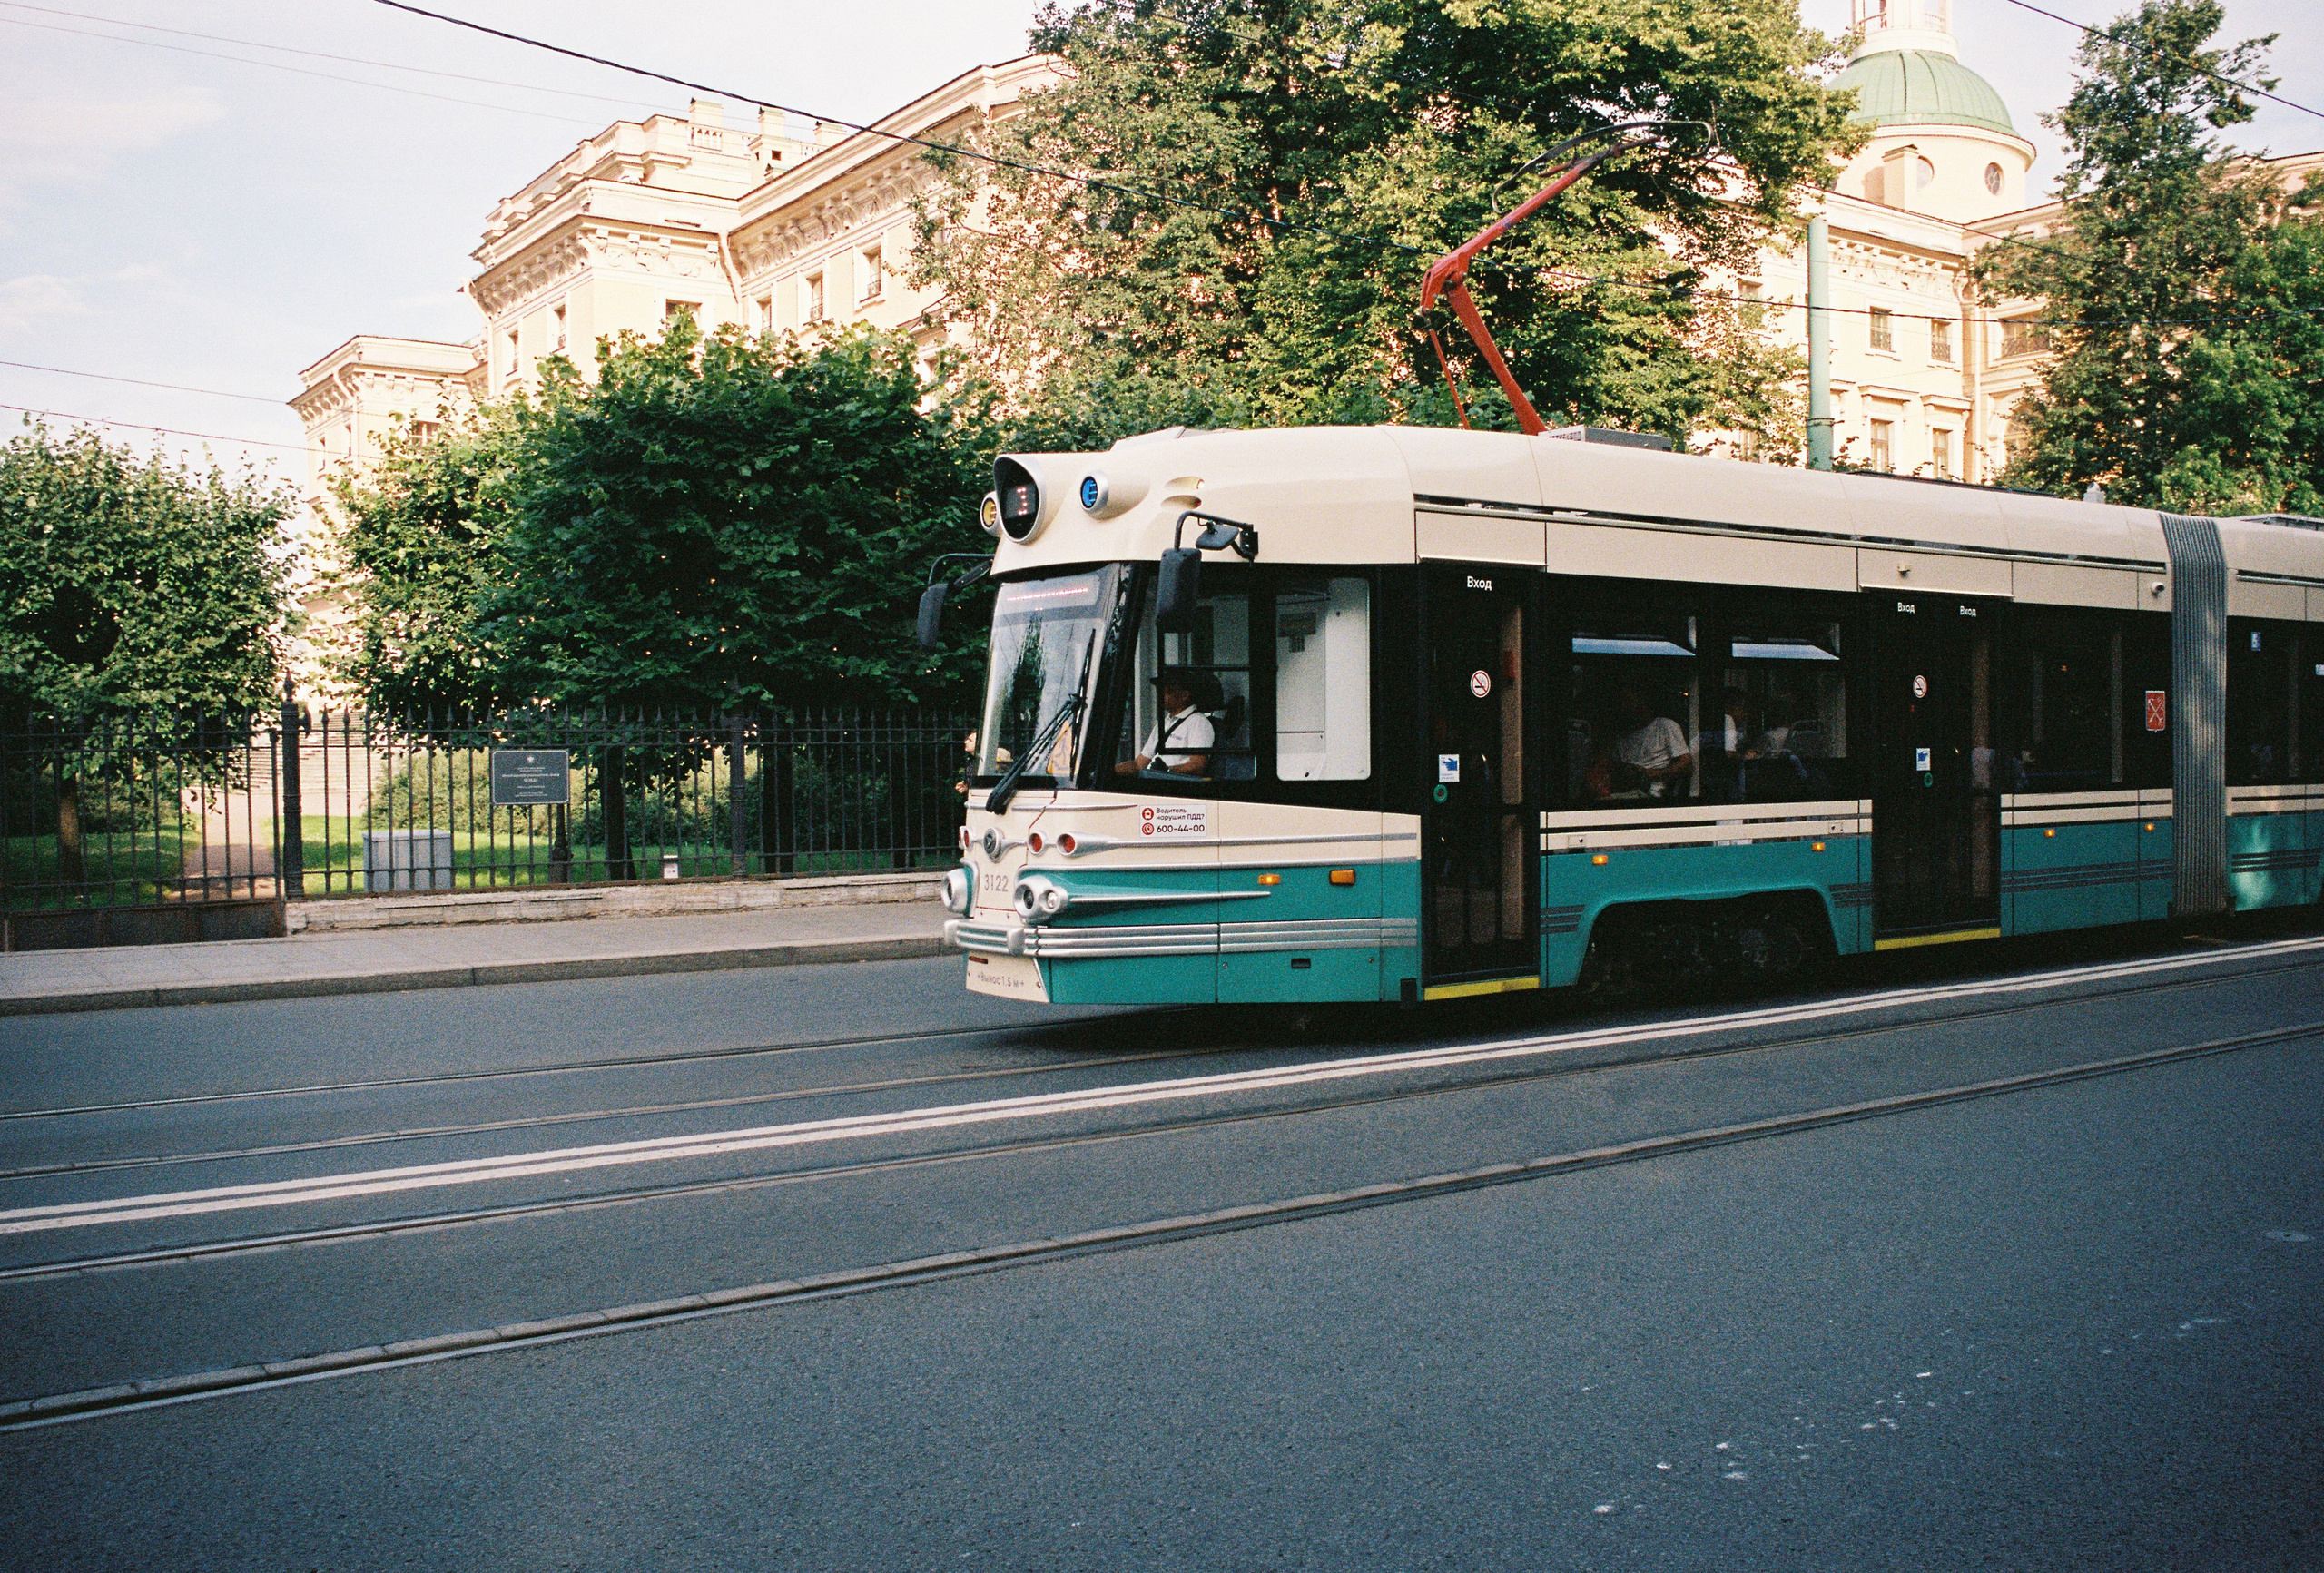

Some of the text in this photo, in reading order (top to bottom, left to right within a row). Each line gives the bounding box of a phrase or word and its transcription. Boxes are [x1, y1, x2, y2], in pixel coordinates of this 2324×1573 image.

[1467, 575, 1492, 591] Вход
[1897, 601, 1915, 614] Вход
[1959, 605, 1977, 617] Вход
[1156, 824, 1205, 832] 600-44-00
[984, 874, 1009, 892] 3122
